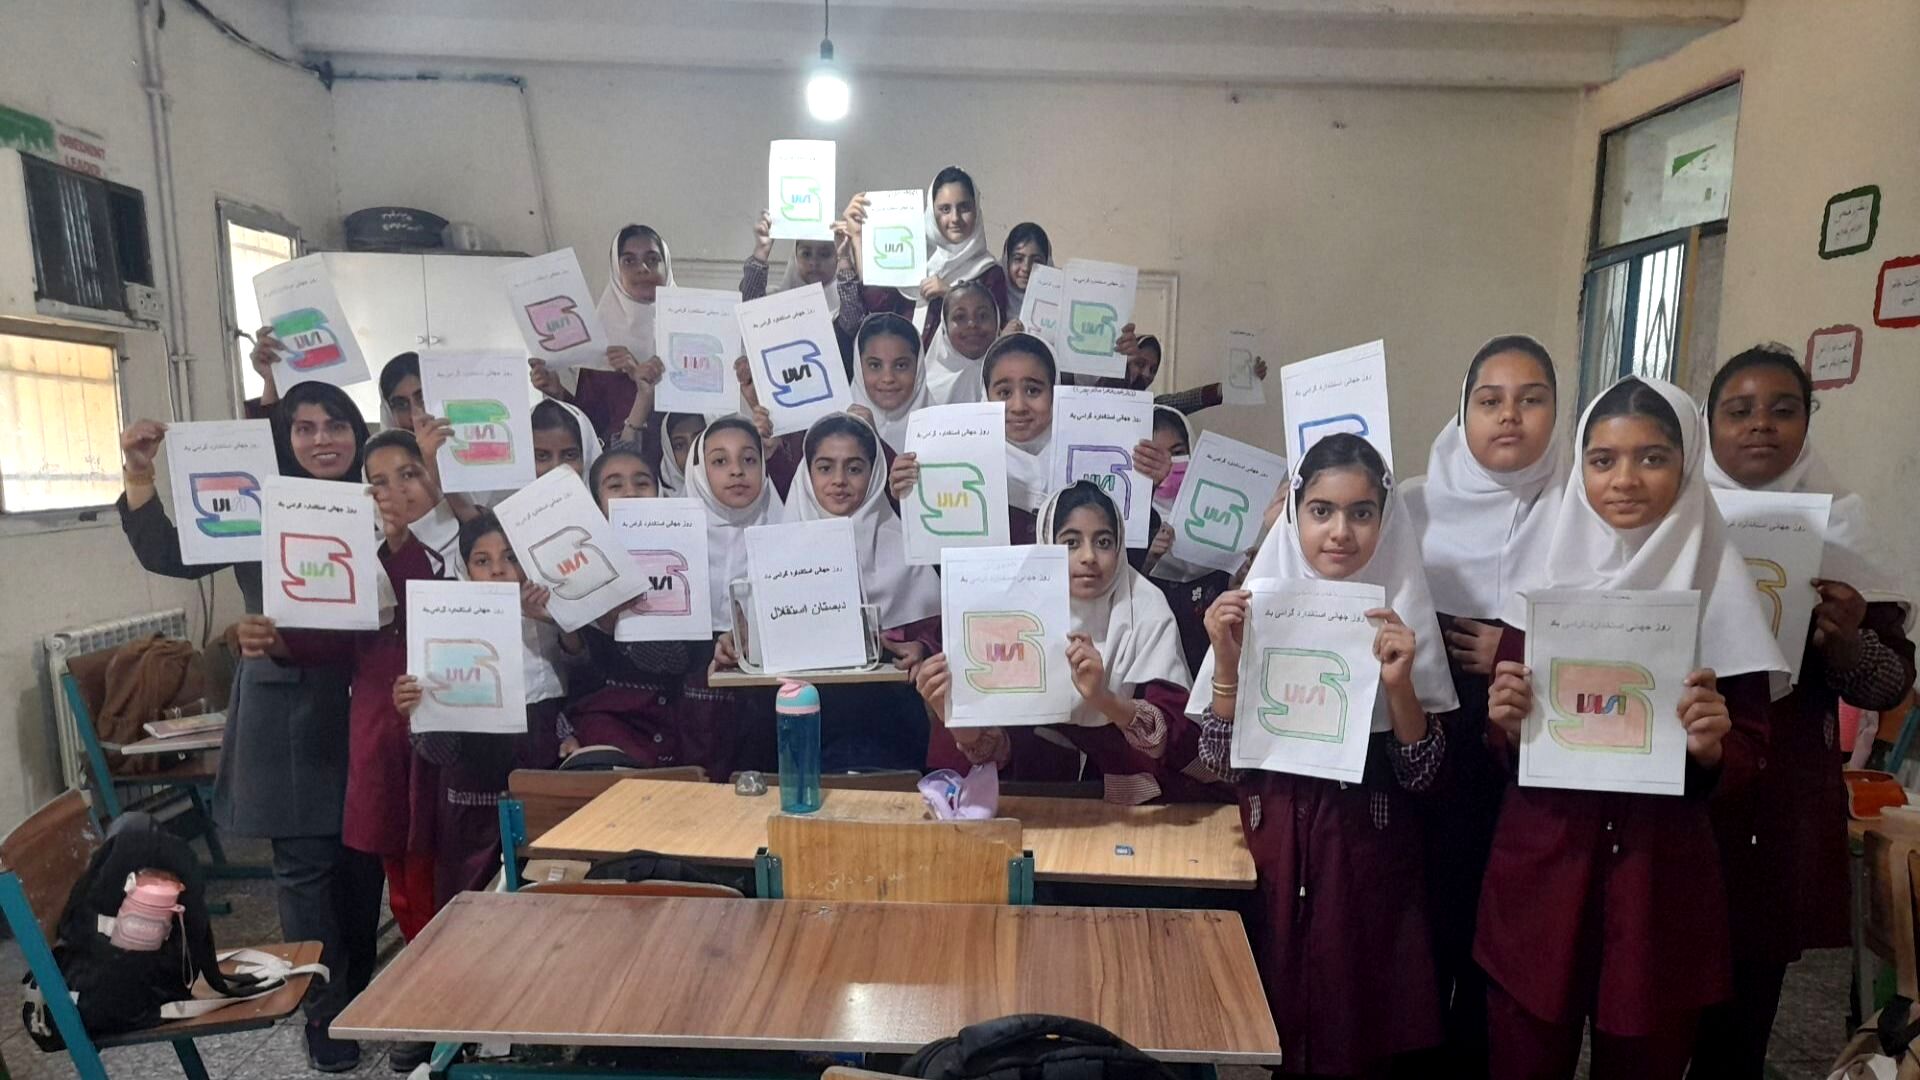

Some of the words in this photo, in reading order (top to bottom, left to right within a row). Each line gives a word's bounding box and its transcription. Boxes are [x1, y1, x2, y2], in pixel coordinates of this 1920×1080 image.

[770, 604, 808, 621] استقلال
[811, 601, 847, 616] دبستان
[1274, 608, 1295, 619] گرامی
[1327, 611, 1349, 622] جهانی
